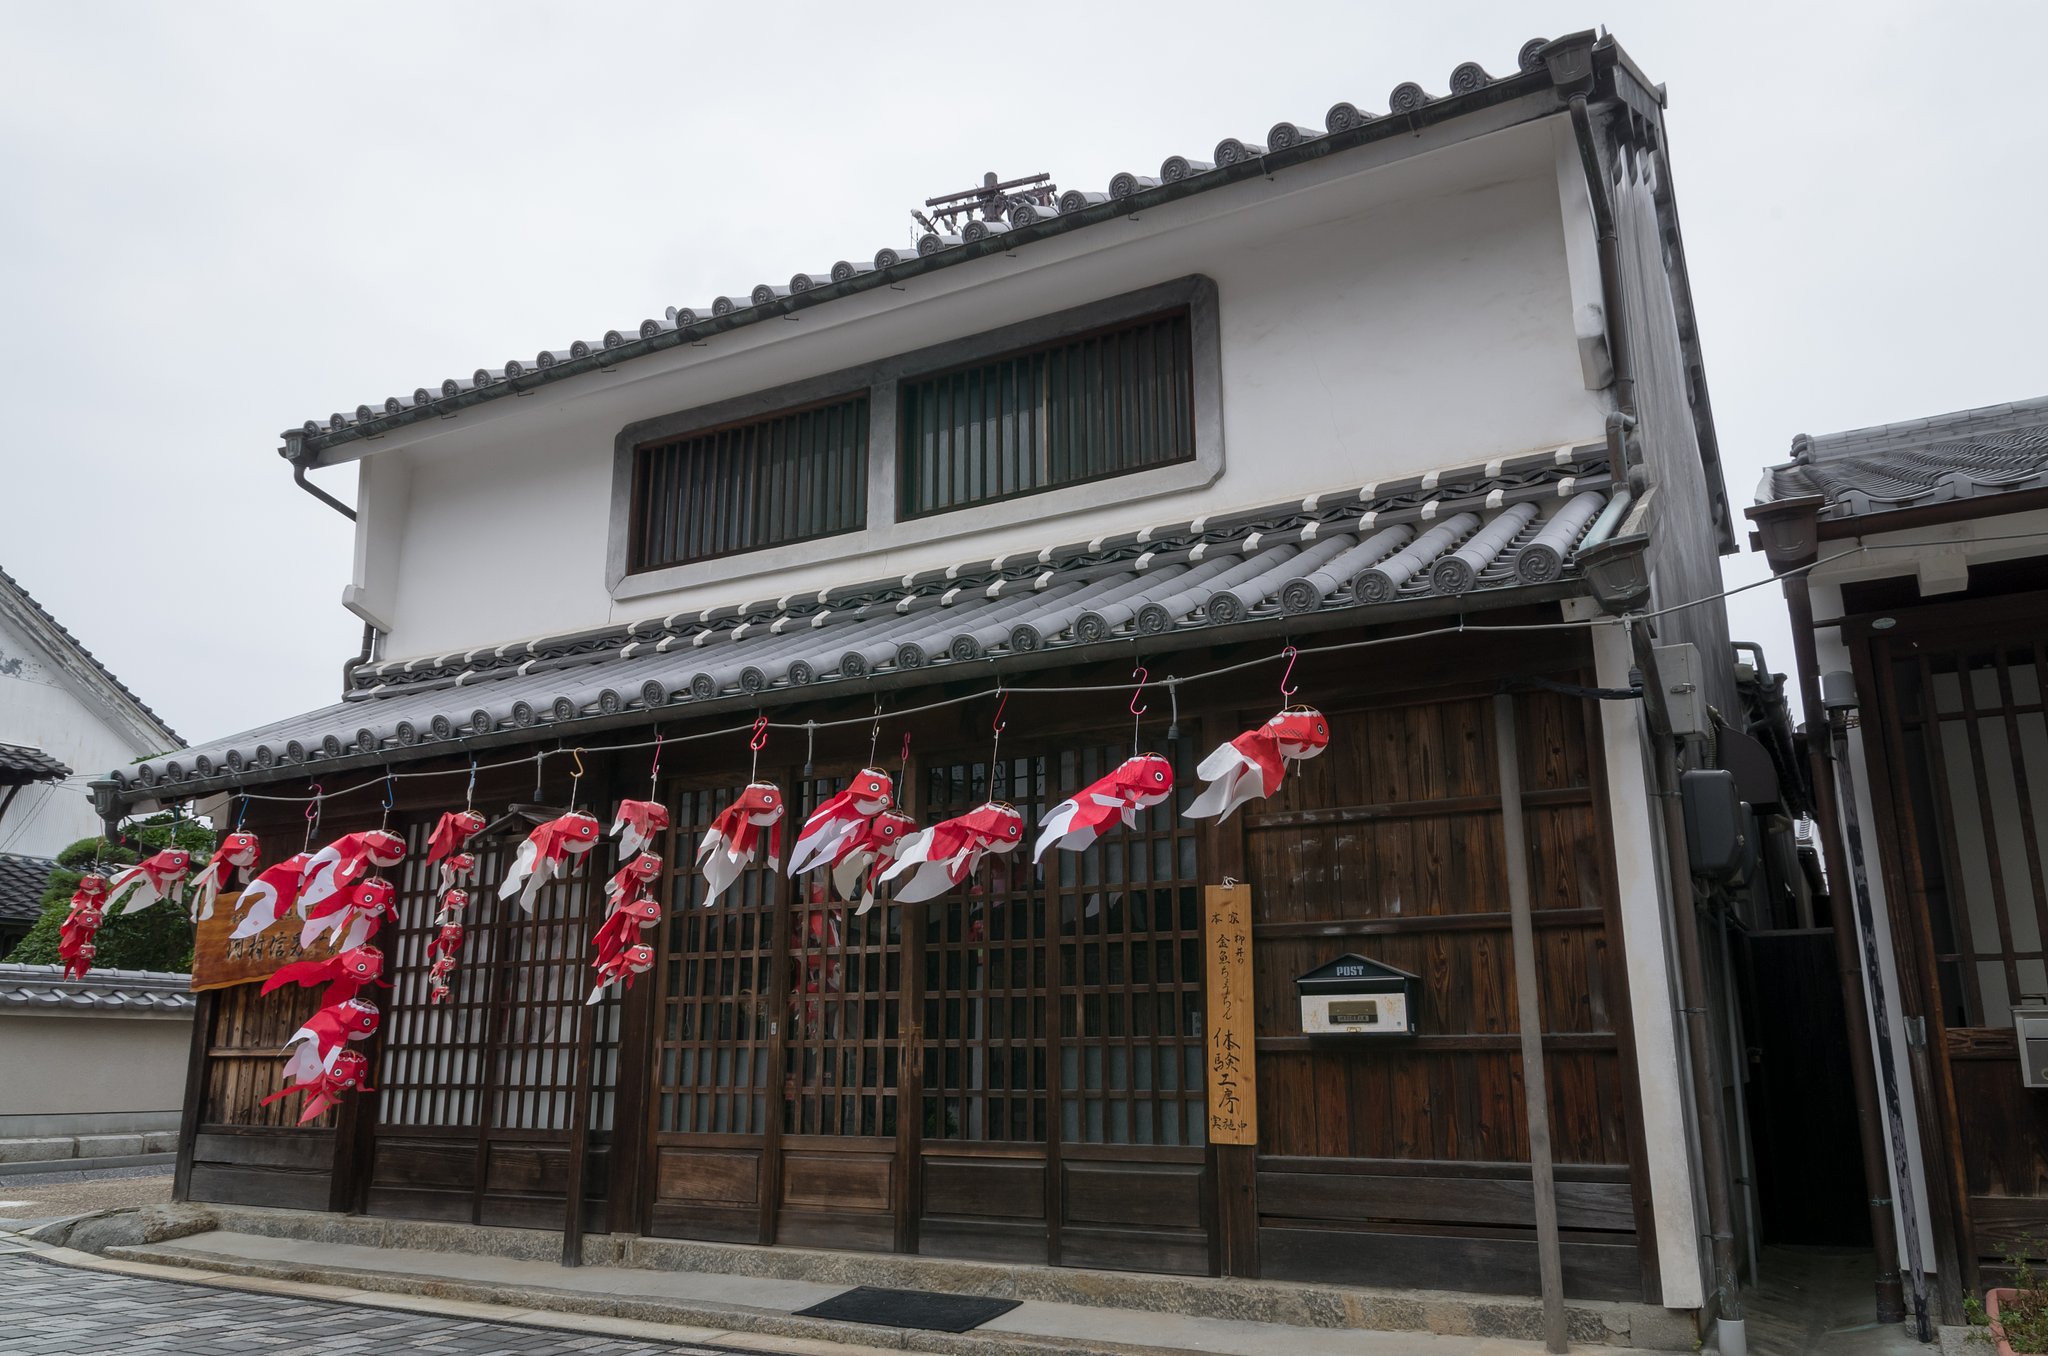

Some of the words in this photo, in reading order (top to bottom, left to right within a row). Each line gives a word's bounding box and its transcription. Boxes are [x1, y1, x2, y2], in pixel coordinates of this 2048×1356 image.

[1211, 911, 1240, 925] 本家
[1216, 933, 1233, 1021] 金魚ちょうちん
[1336, 965, 1364, 976] POST
[1213, 1026, 1241, 1114] 体験工房
